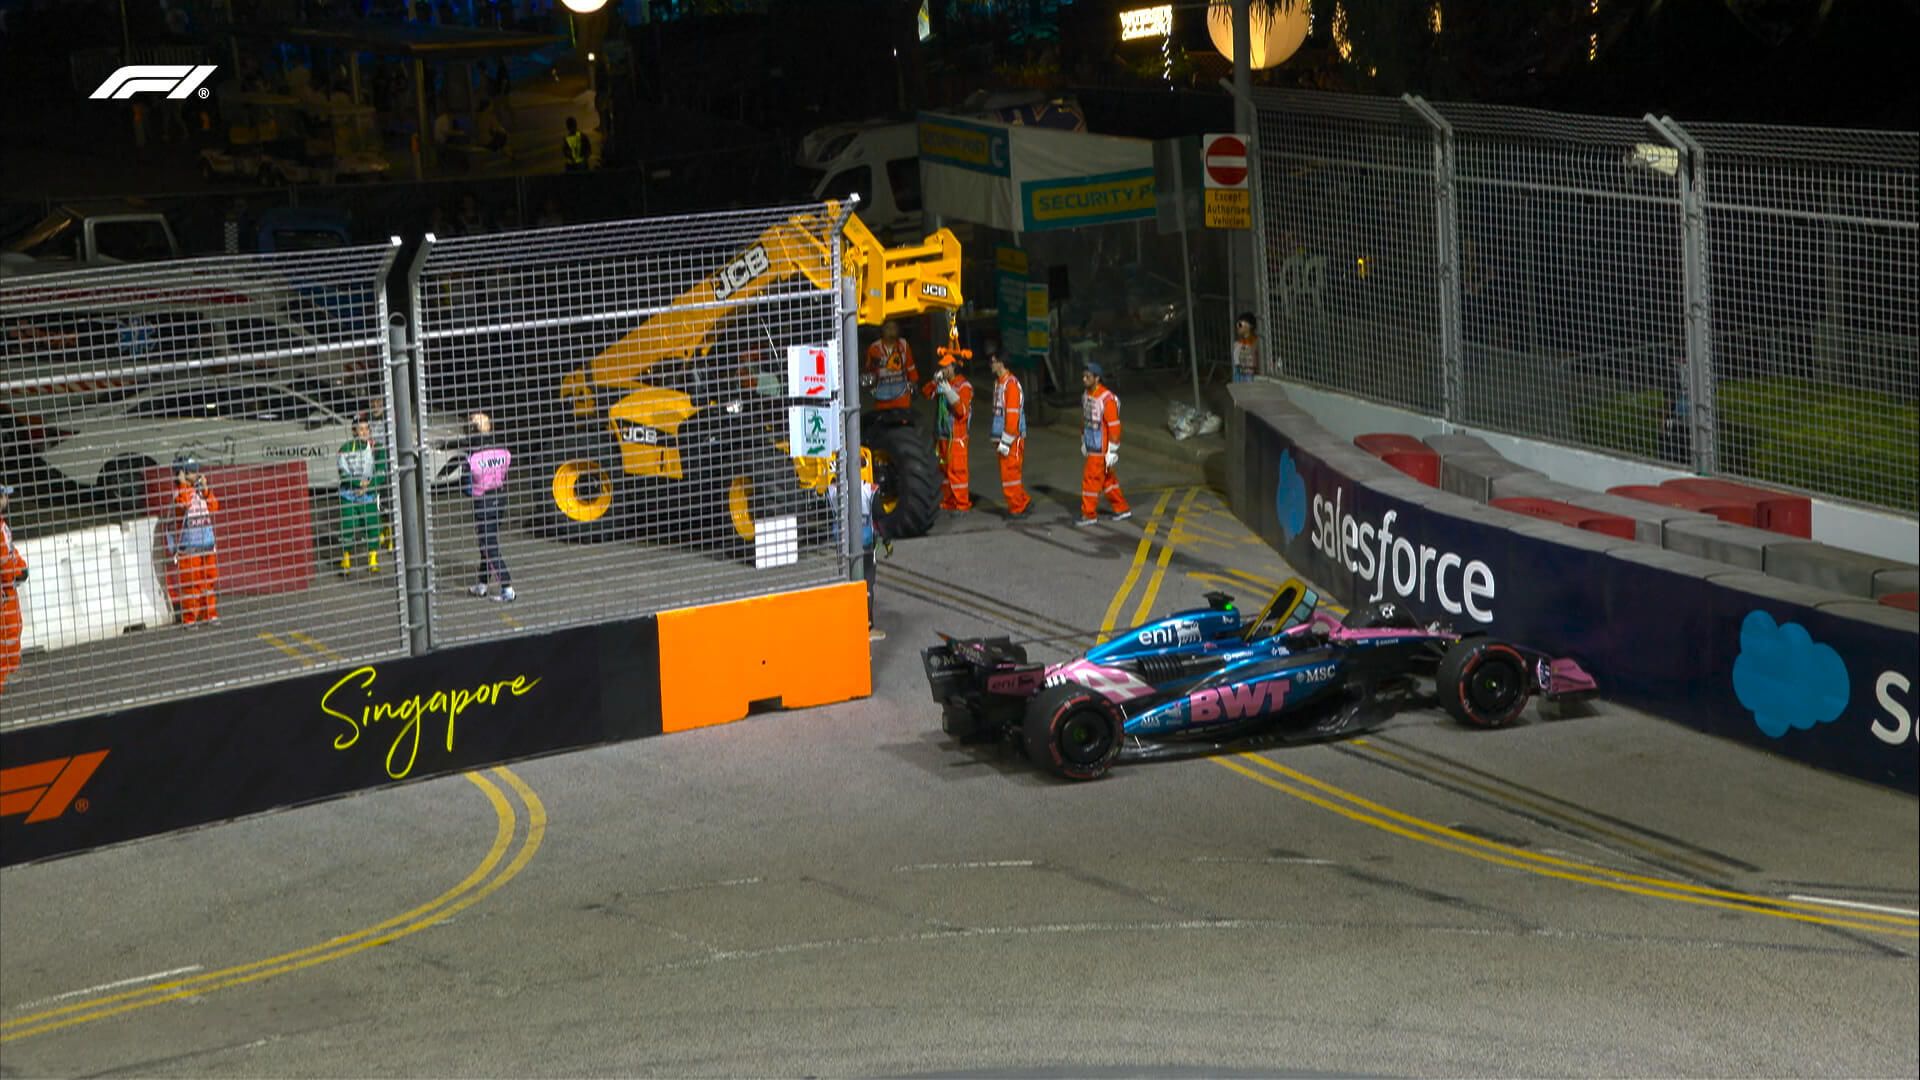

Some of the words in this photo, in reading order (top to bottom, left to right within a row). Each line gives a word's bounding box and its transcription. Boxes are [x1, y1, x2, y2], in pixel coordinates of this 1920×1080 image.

[1039, 187, 1133, 211] SECURITY
[1214, 191, 1241, 202] Except
[1213, 215, 1245, 225] Vehicles
[714, 245, 769, 300] JCB
[922, 285, 947, 297] JCB
[622, 426, 658, 444] JCB
[265, 446, 323, 457] MEDICAL
[1312, 486, 1496, 623] salesforce
[1138, 626, 1172, 646] eni
[1306, 664, 1336, 683] MSC
[1190, 680, 1290, 722] BWT
[1871, 670, 1919, 745] s
[321, 666, 542, 780] Singapore
